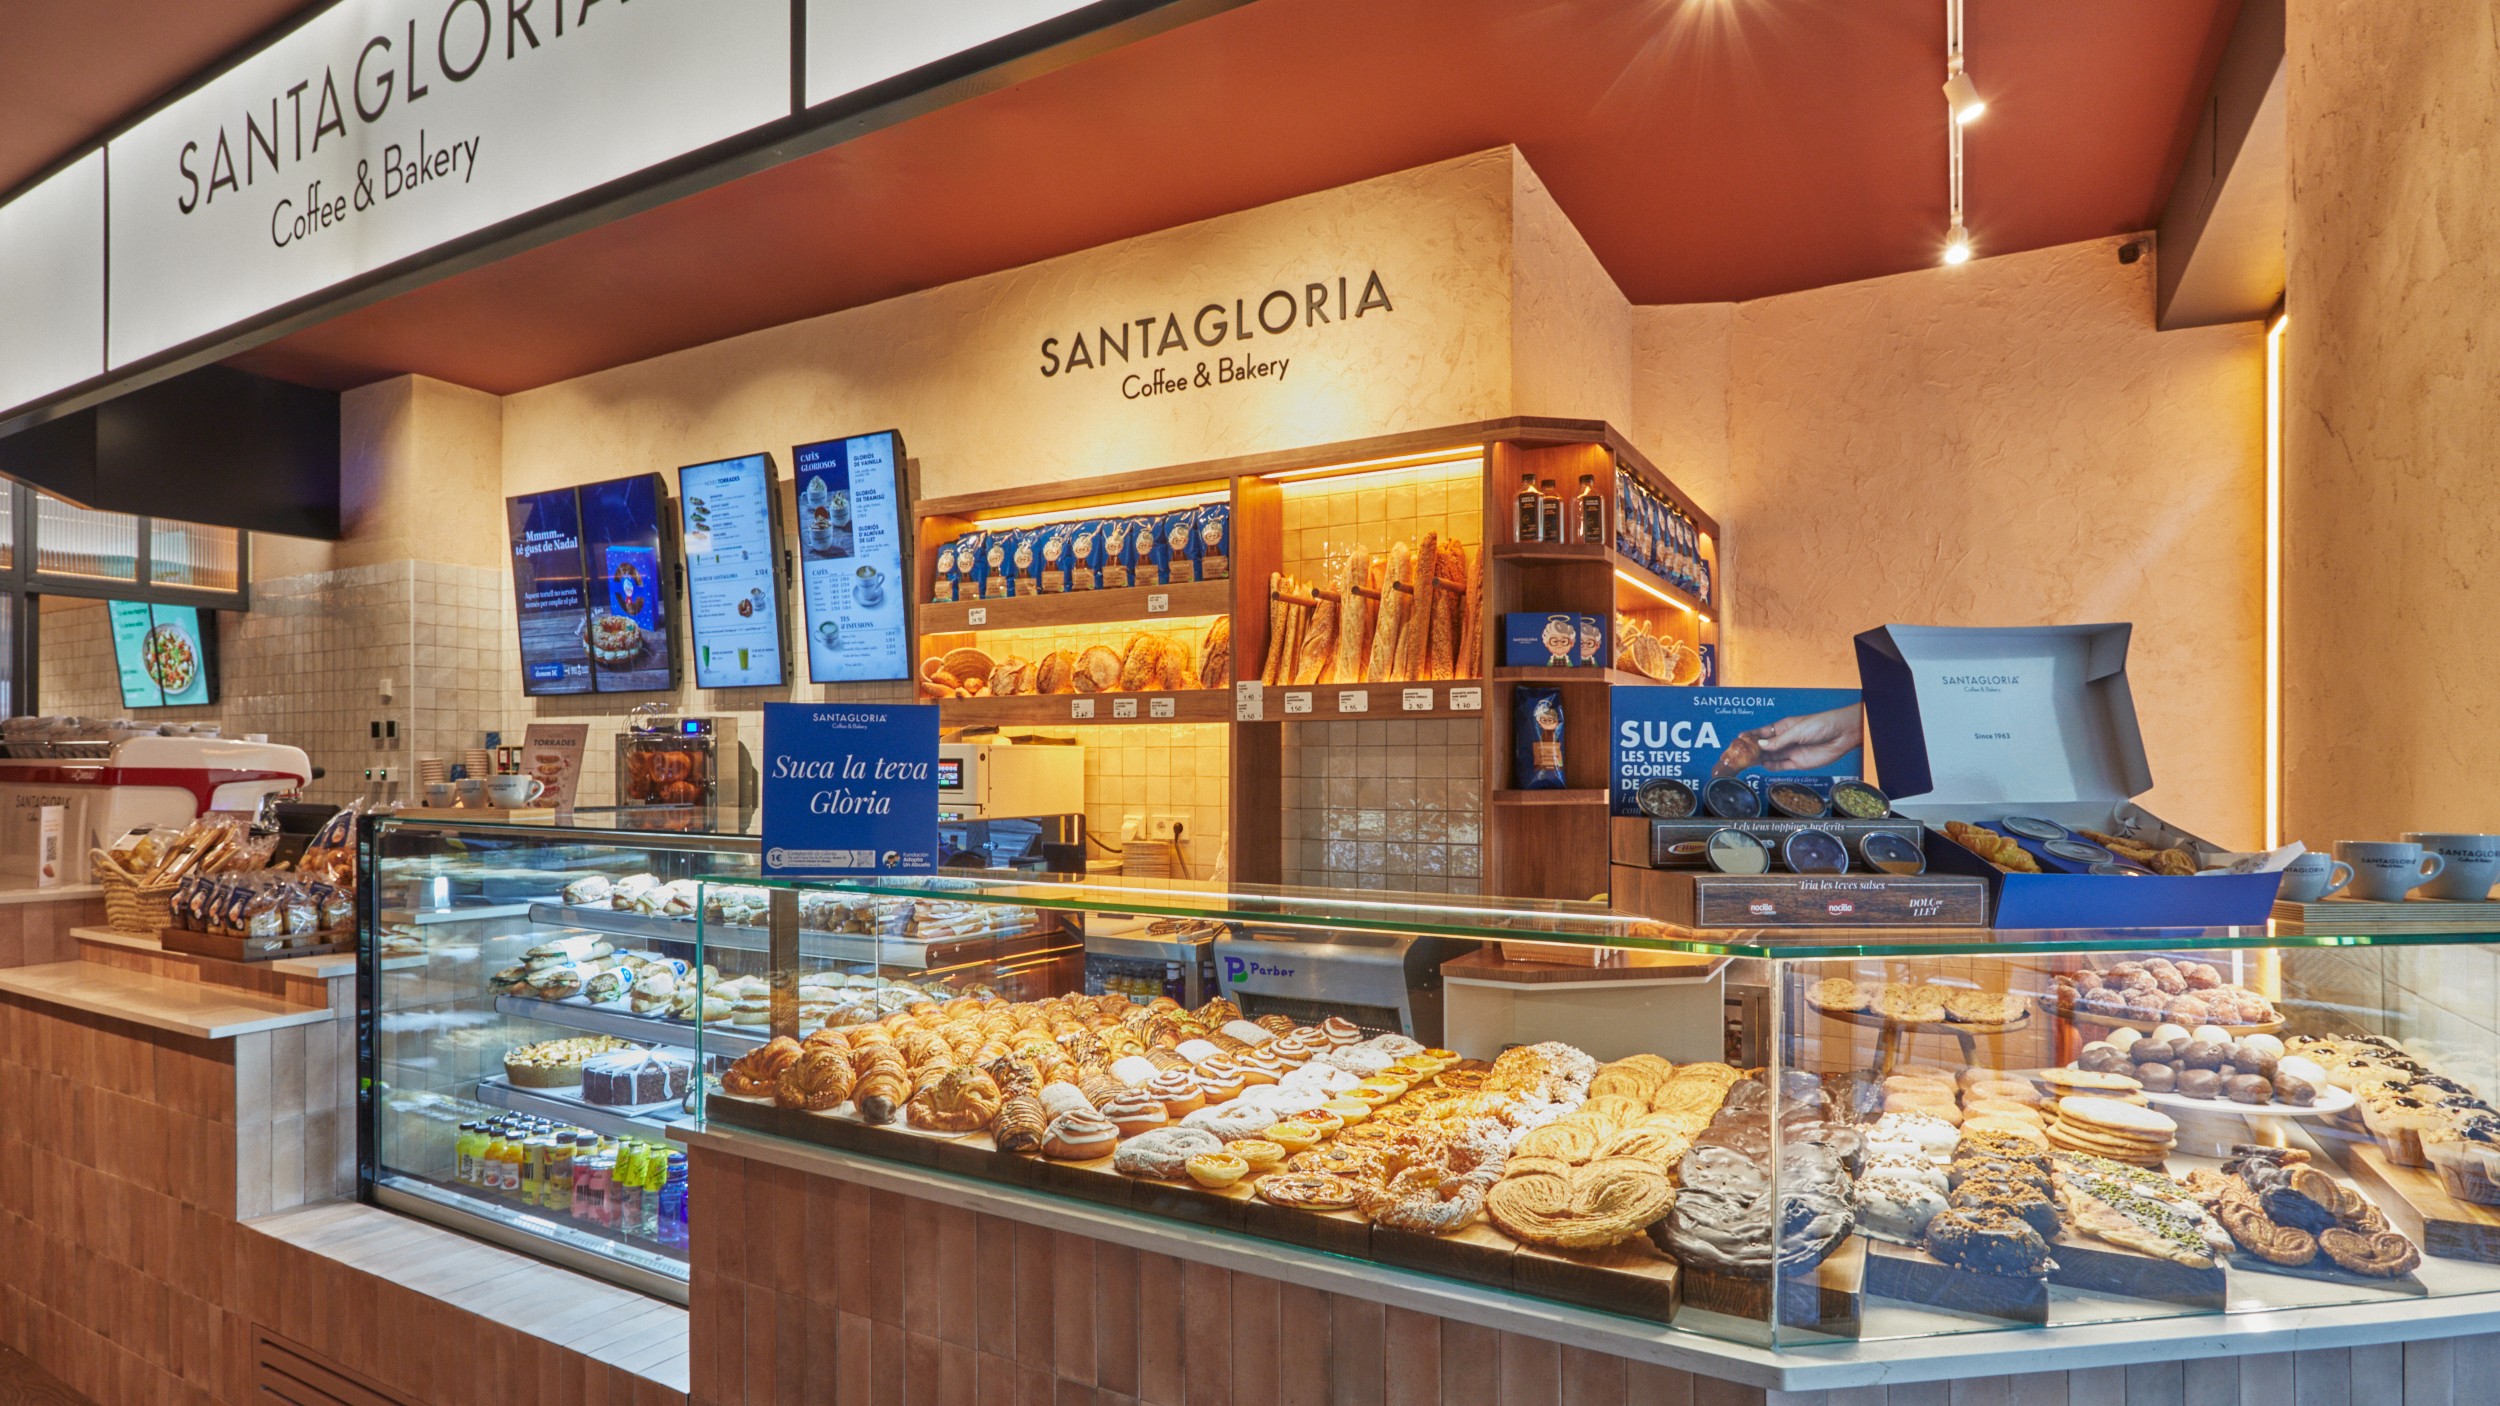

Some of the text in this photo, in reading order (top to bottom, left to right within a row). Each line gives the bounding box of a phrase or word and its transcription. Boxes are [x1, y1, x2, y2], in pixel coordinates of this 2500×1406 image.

[178, 0, 629, 215] SANTAGLOR
[272, 129, 481, 248] Coffee & Bakery
[1040, 269, 1393, 378] SANTAGLORIA
[1122, 353, 1290, 400] Coffee & Bakery
[800, 460, 837, 473] GLORIOSOS
[524, 543, 542, 557] gust
[542, 540, 553, 552] de
[554, 536, 578, 551] Nadal
[1942, 675, 2019, 685] SANTAGLORIA
[1693, 696, 1775, 707] SANTAGLORIA
[1738, 707, 1754, 715] Bakery
[813, 713, 887, 722] SANTAGLORIA
[1620, 720, 1721, 748] SUCA
[533, 739, 576, 747] TORRADES
[1622, 751, 1690, 763] LES TEVES
[772, 754, 929, 780] Suca la teva
[1622, 761, 1682, 777] GLÒRIES
[1622, 779, 1639, 791] DE
[810, 787, 891, 815] Glòria
[1752, 822, 1770, 831] teus
[1771, 822, 1808, 833] toppings
[1810, 822, 1845, 832] preferits
[2438, 848, 2500, 857] SANTAGLOR
[1799, 880, 1886, 890] Tria les teves salses
[1750, 904, 1773, 912] nocilla
[1828, 903, 1853, 912] nocilla
[1913, 907, 1937, 916] LLET
[1250, 962, 1295, 977] Parber
